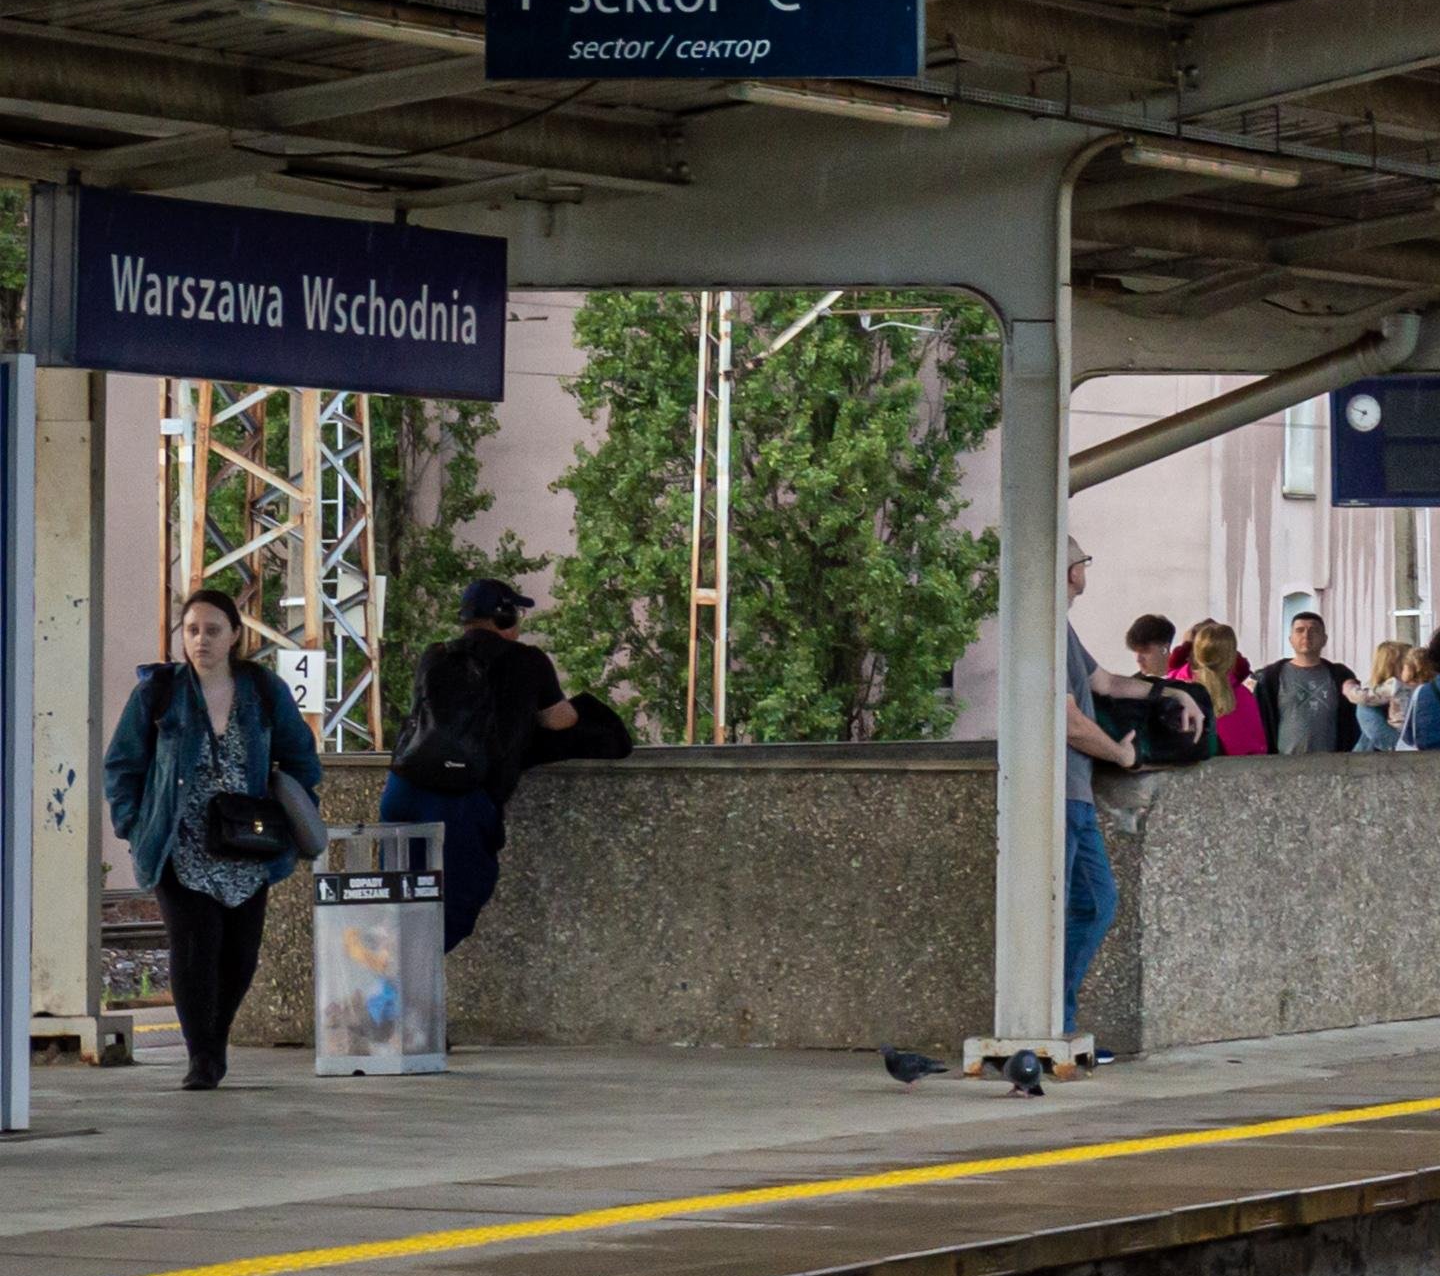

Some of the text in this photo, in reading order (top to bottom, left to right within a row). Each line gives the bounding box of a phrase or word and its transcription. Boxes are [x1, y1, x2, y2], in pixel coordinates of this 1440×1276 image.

[568, 37, 655, 60] sector
[676, 38, 771, 64] сектор
[110, 254, 478, 345] Warszawa Wschodnia
[295, 654, 308, 679] 4
[294, 684, 307, 709] 2
